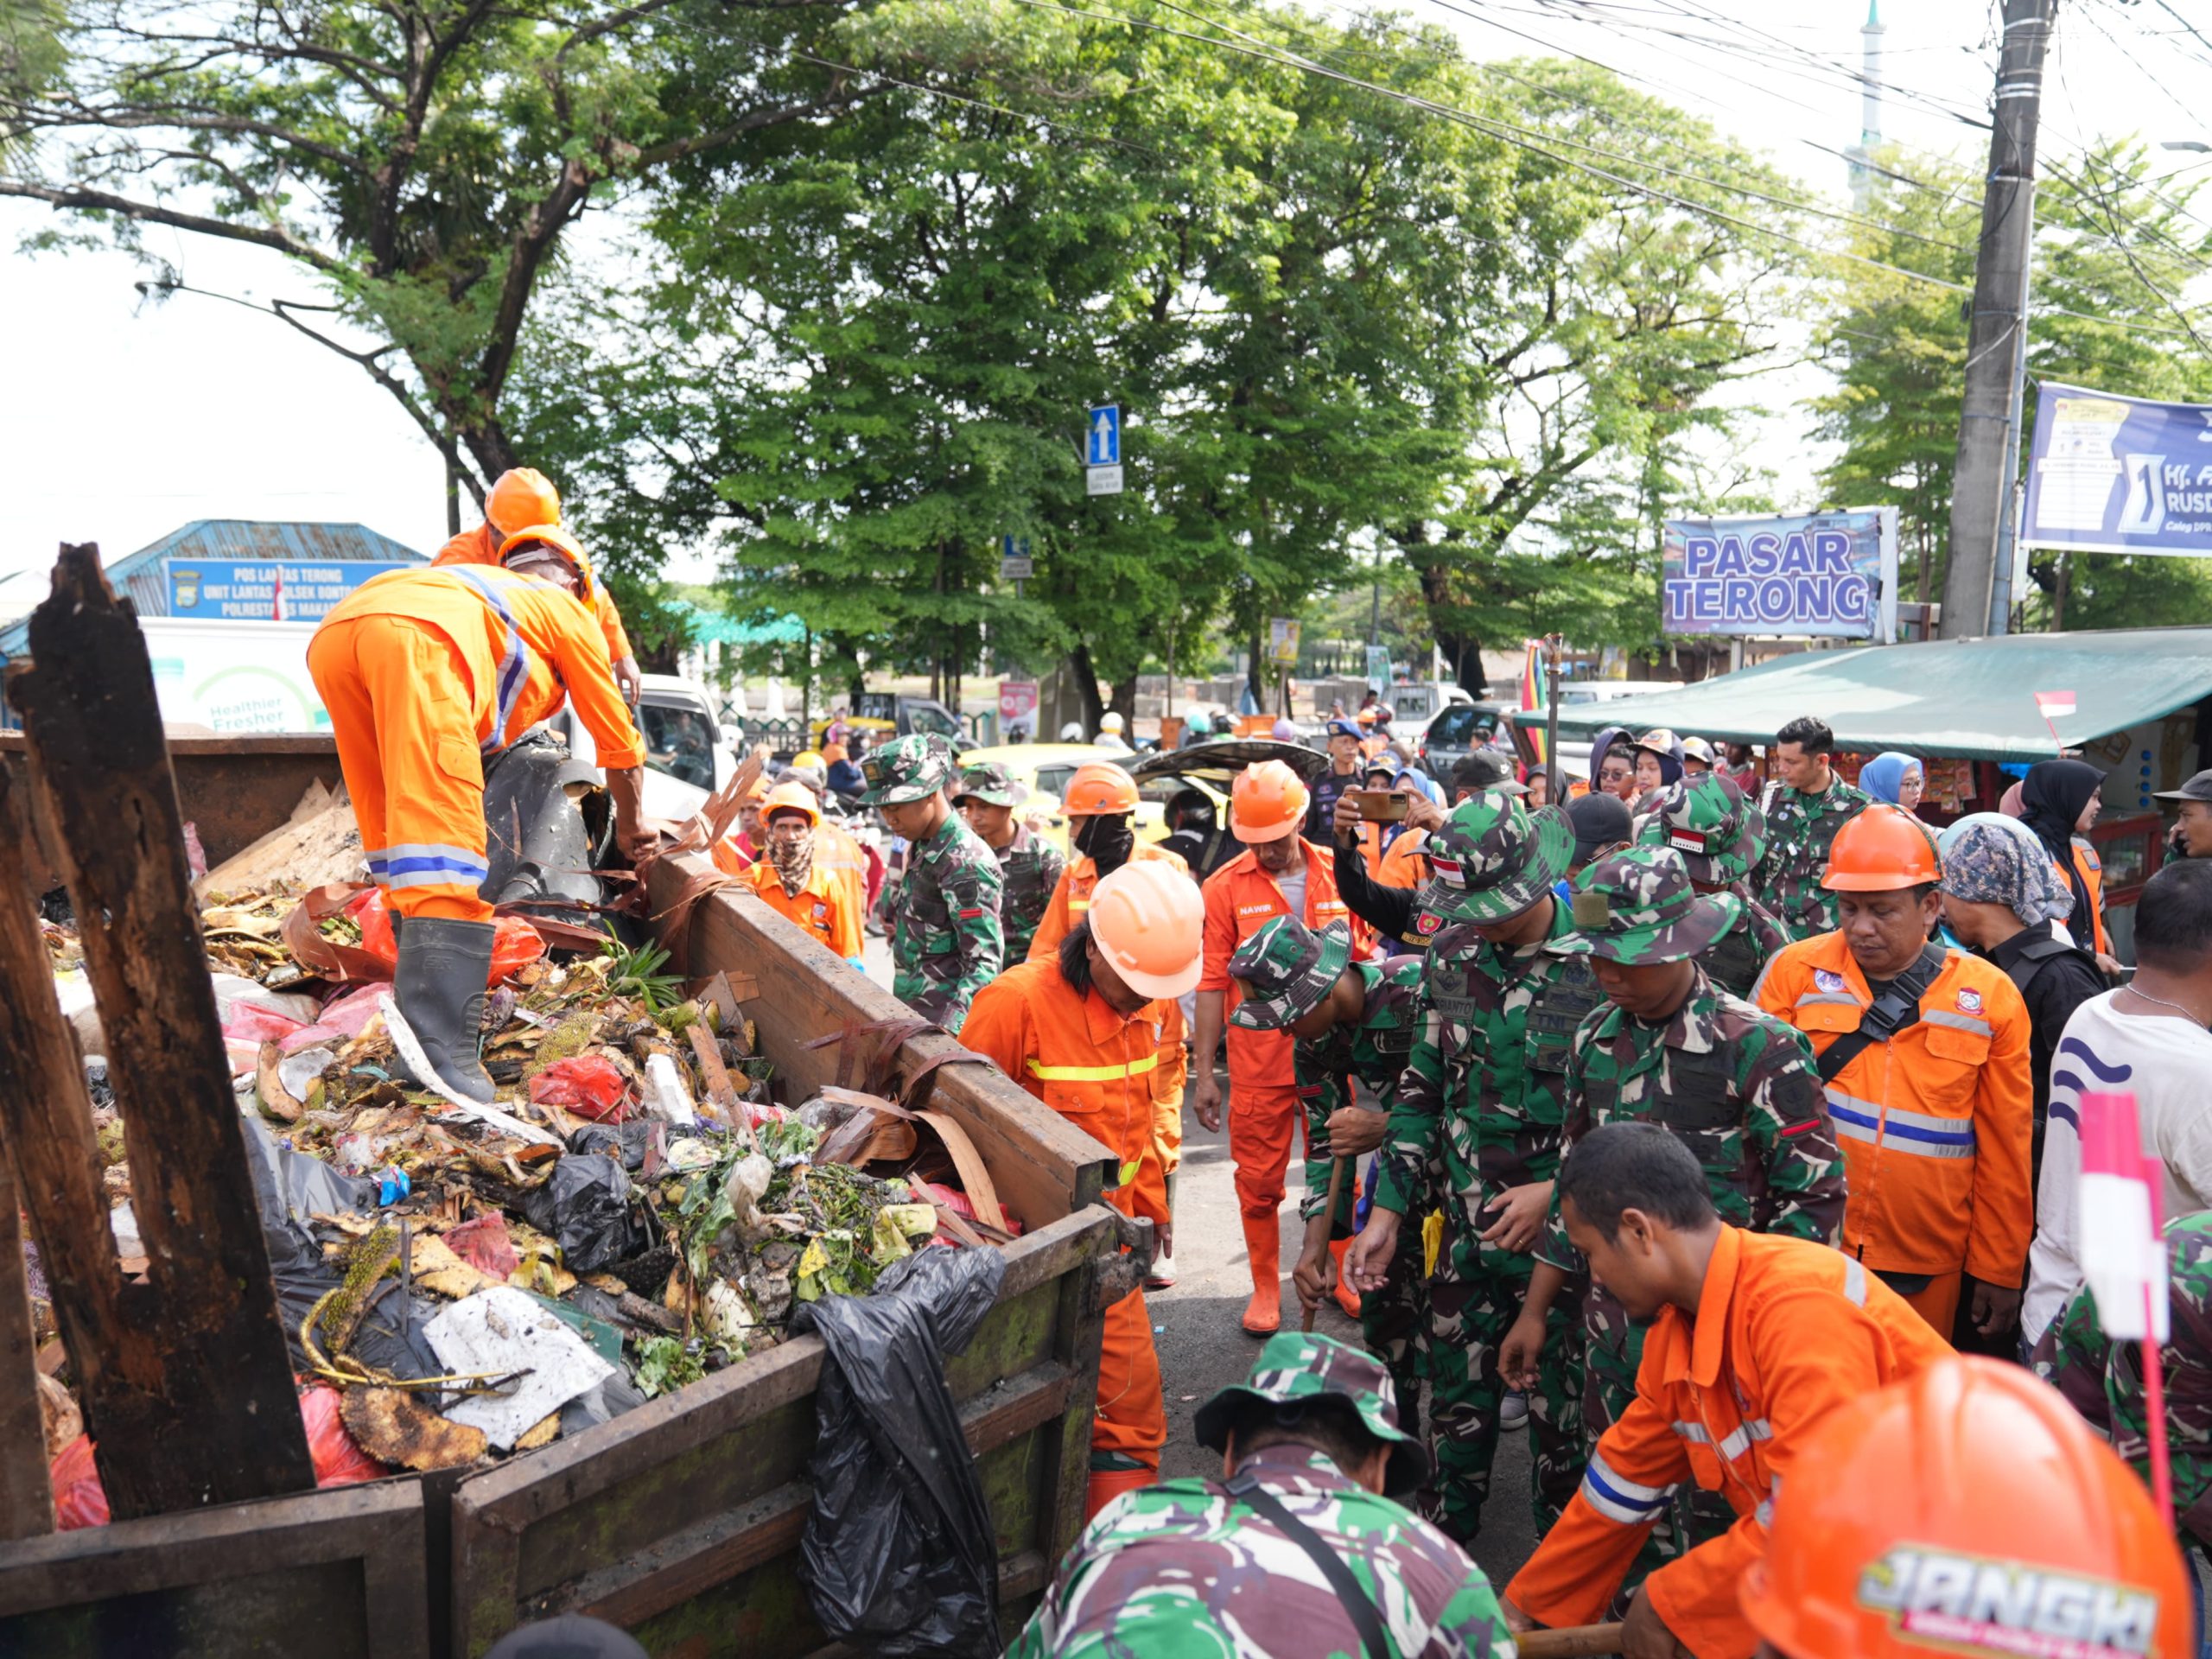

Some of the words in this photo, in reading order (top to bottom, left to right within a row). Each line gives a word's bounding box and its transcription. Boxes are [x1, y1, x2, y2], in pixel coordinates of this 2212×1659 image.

[1685, 531, 1851, 578] PASAR
[234, 569, 256, 582] POS
[259, 569, 298, 582] LANAS
[301, 569, 343, 583] TERONG
[203, 585, 229, 600] UNIT
[232, 585, 273, 601] LANTAS
[282, 586, 315, 601] OLSEK
[1665, 575, 1869, 620] TERONG
[210, 698, 283, 718] Healthier
[213, 710, 283, 734] Fresher
[1239, 904, 1272, 916] NAWIR
[1536, 1013, 1566, 1029] TNI
